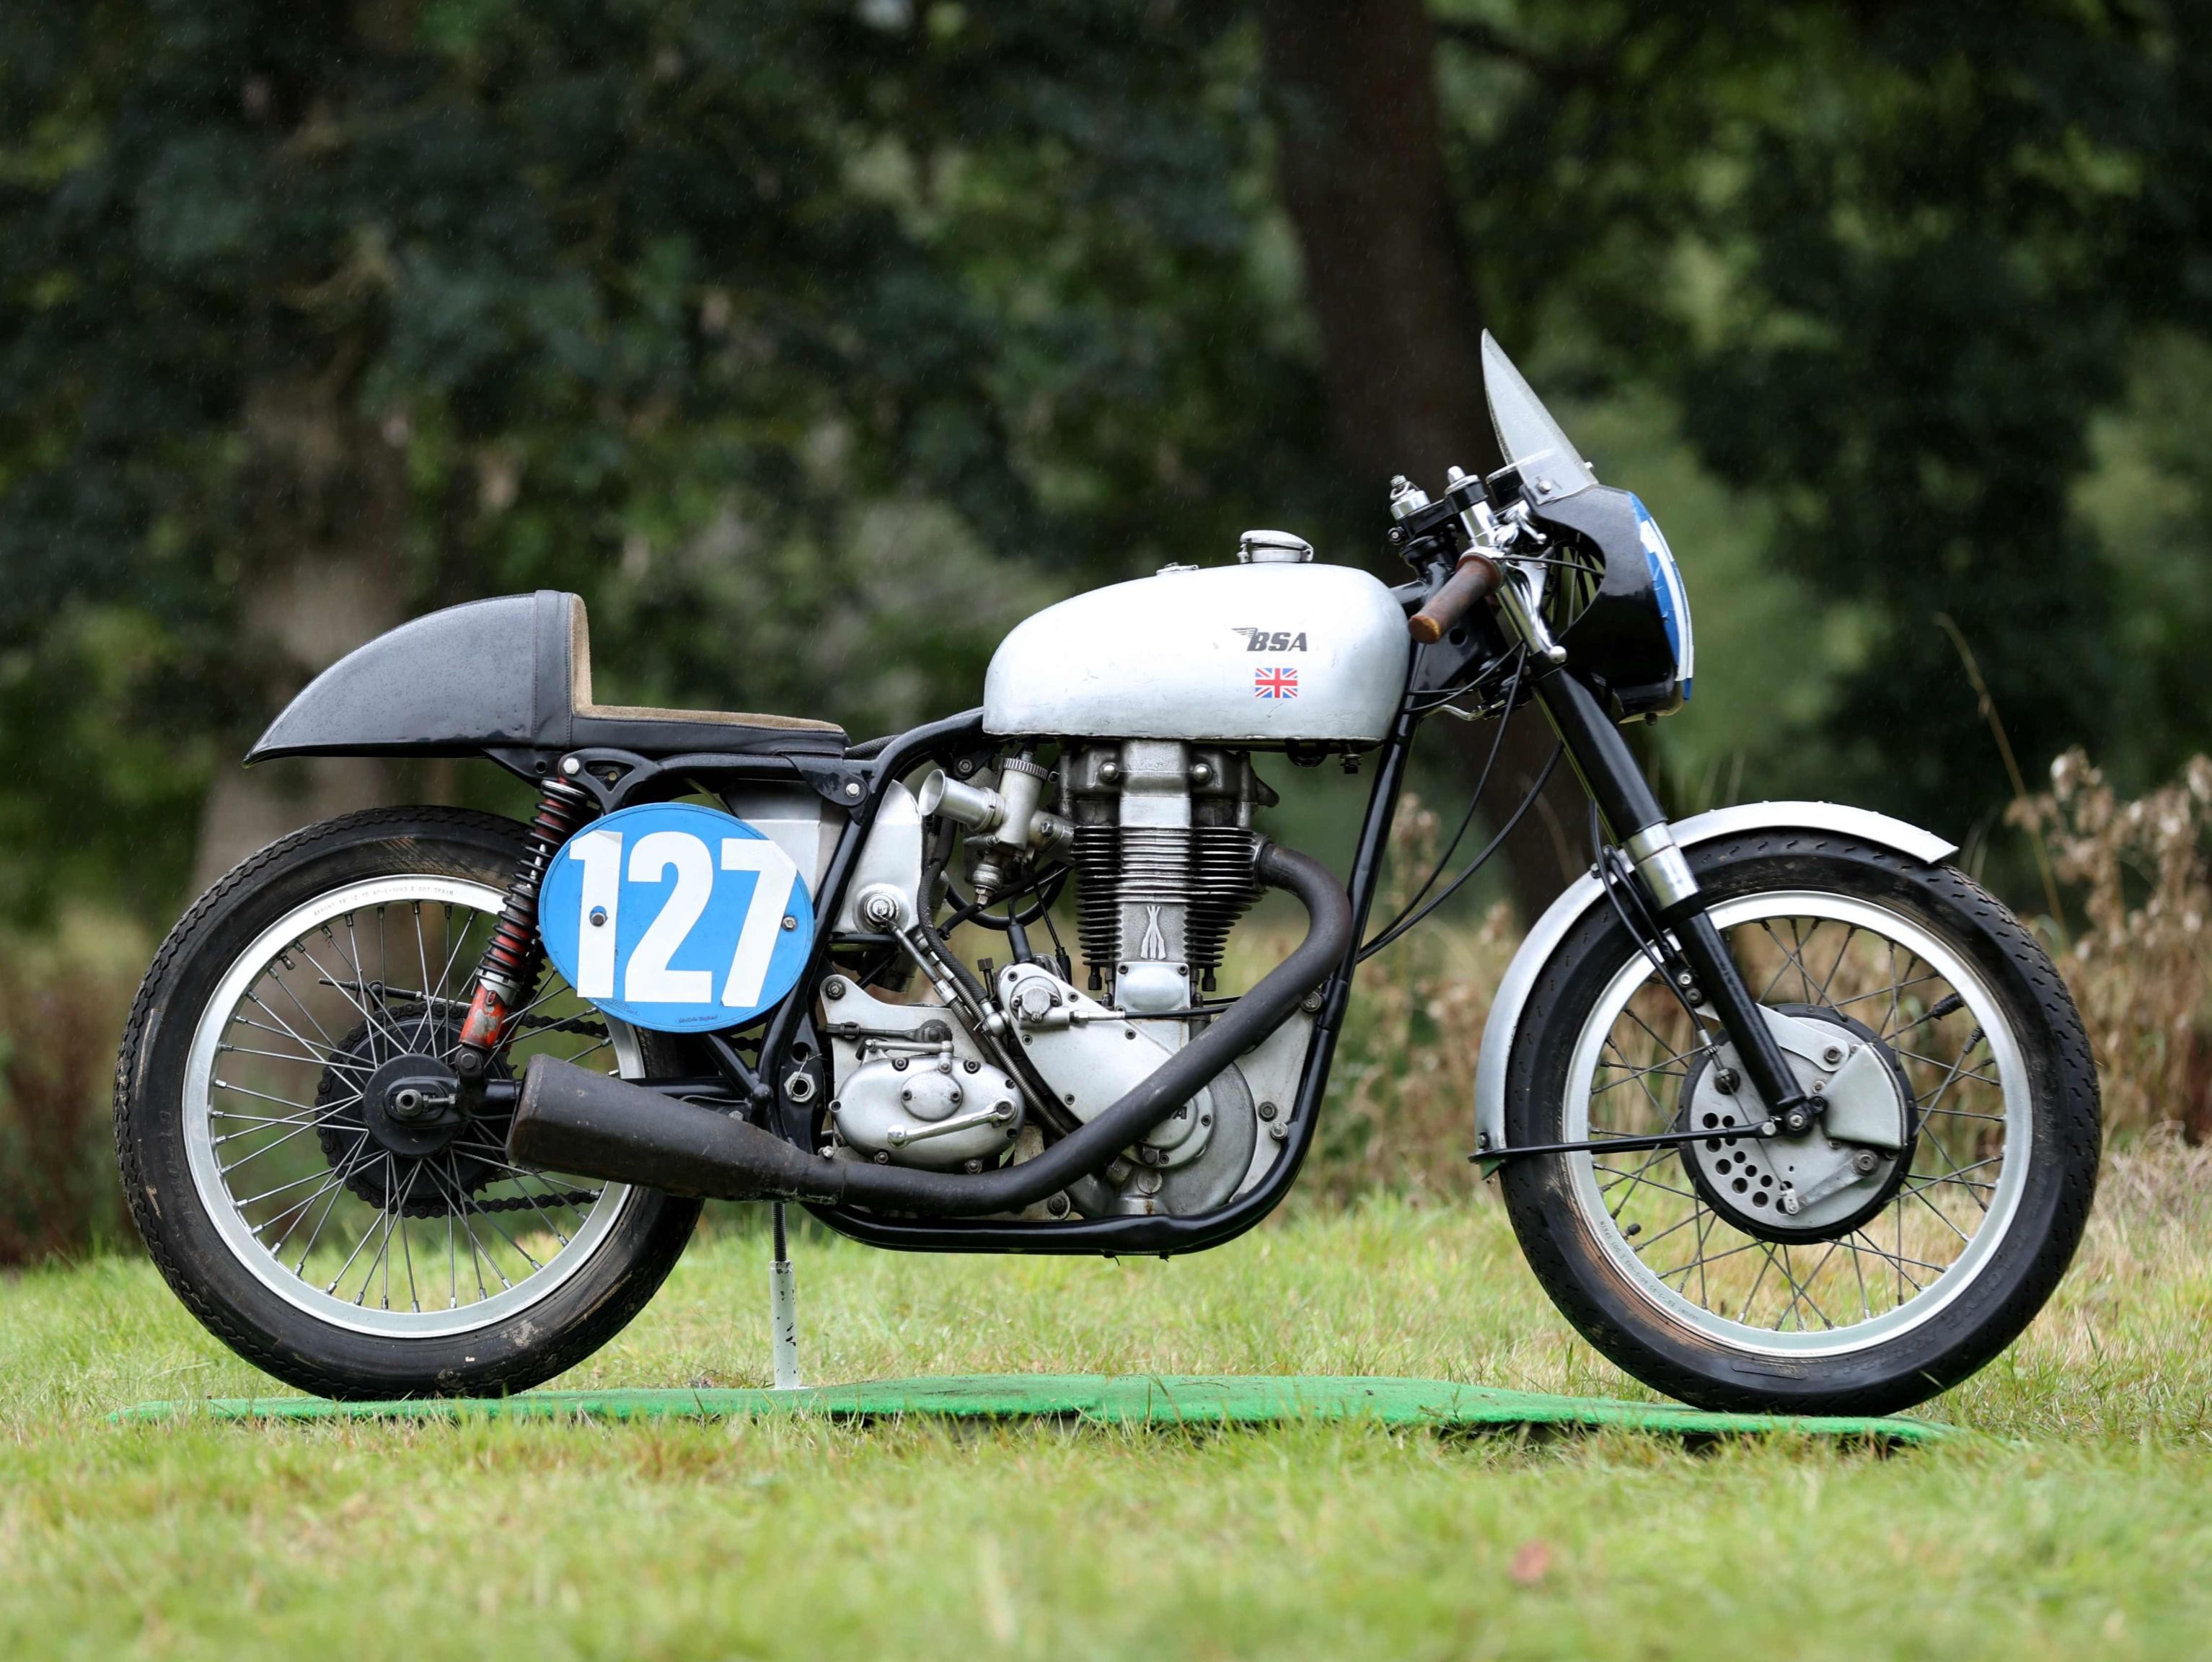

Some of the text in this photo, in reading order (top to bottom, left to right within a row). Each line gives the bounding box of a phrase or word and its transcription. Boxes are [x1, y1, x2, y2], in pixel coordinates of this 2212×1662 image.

[1246, 630, 1308, 651] BSA
[569, 830, 798, 1007] 127
[1599, 1221, 1613, 1239] SPAIN
